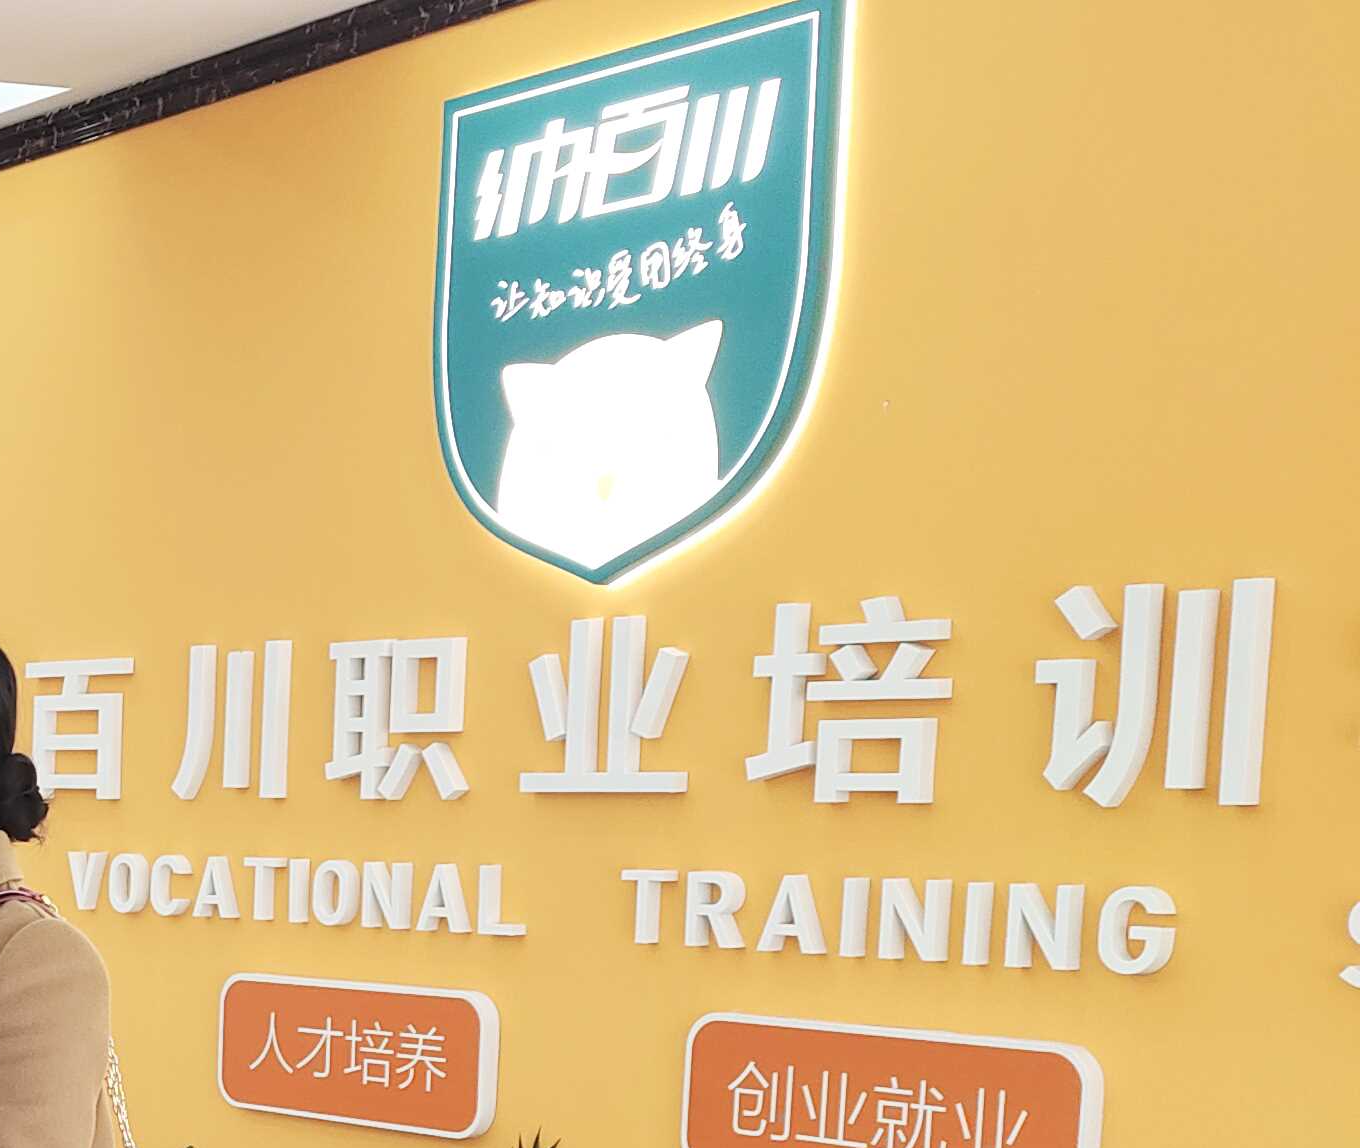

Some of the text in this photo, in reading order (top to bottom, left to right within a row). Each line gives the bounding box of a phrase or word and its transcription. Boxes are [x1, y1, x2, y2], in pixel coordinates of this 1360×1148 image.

[473, 77, 782, 241] 纳百川
[67, 850, 1178, 976] VOCATIONAL TRAINING
[248, 1012, 448, 1093] 人才培养
